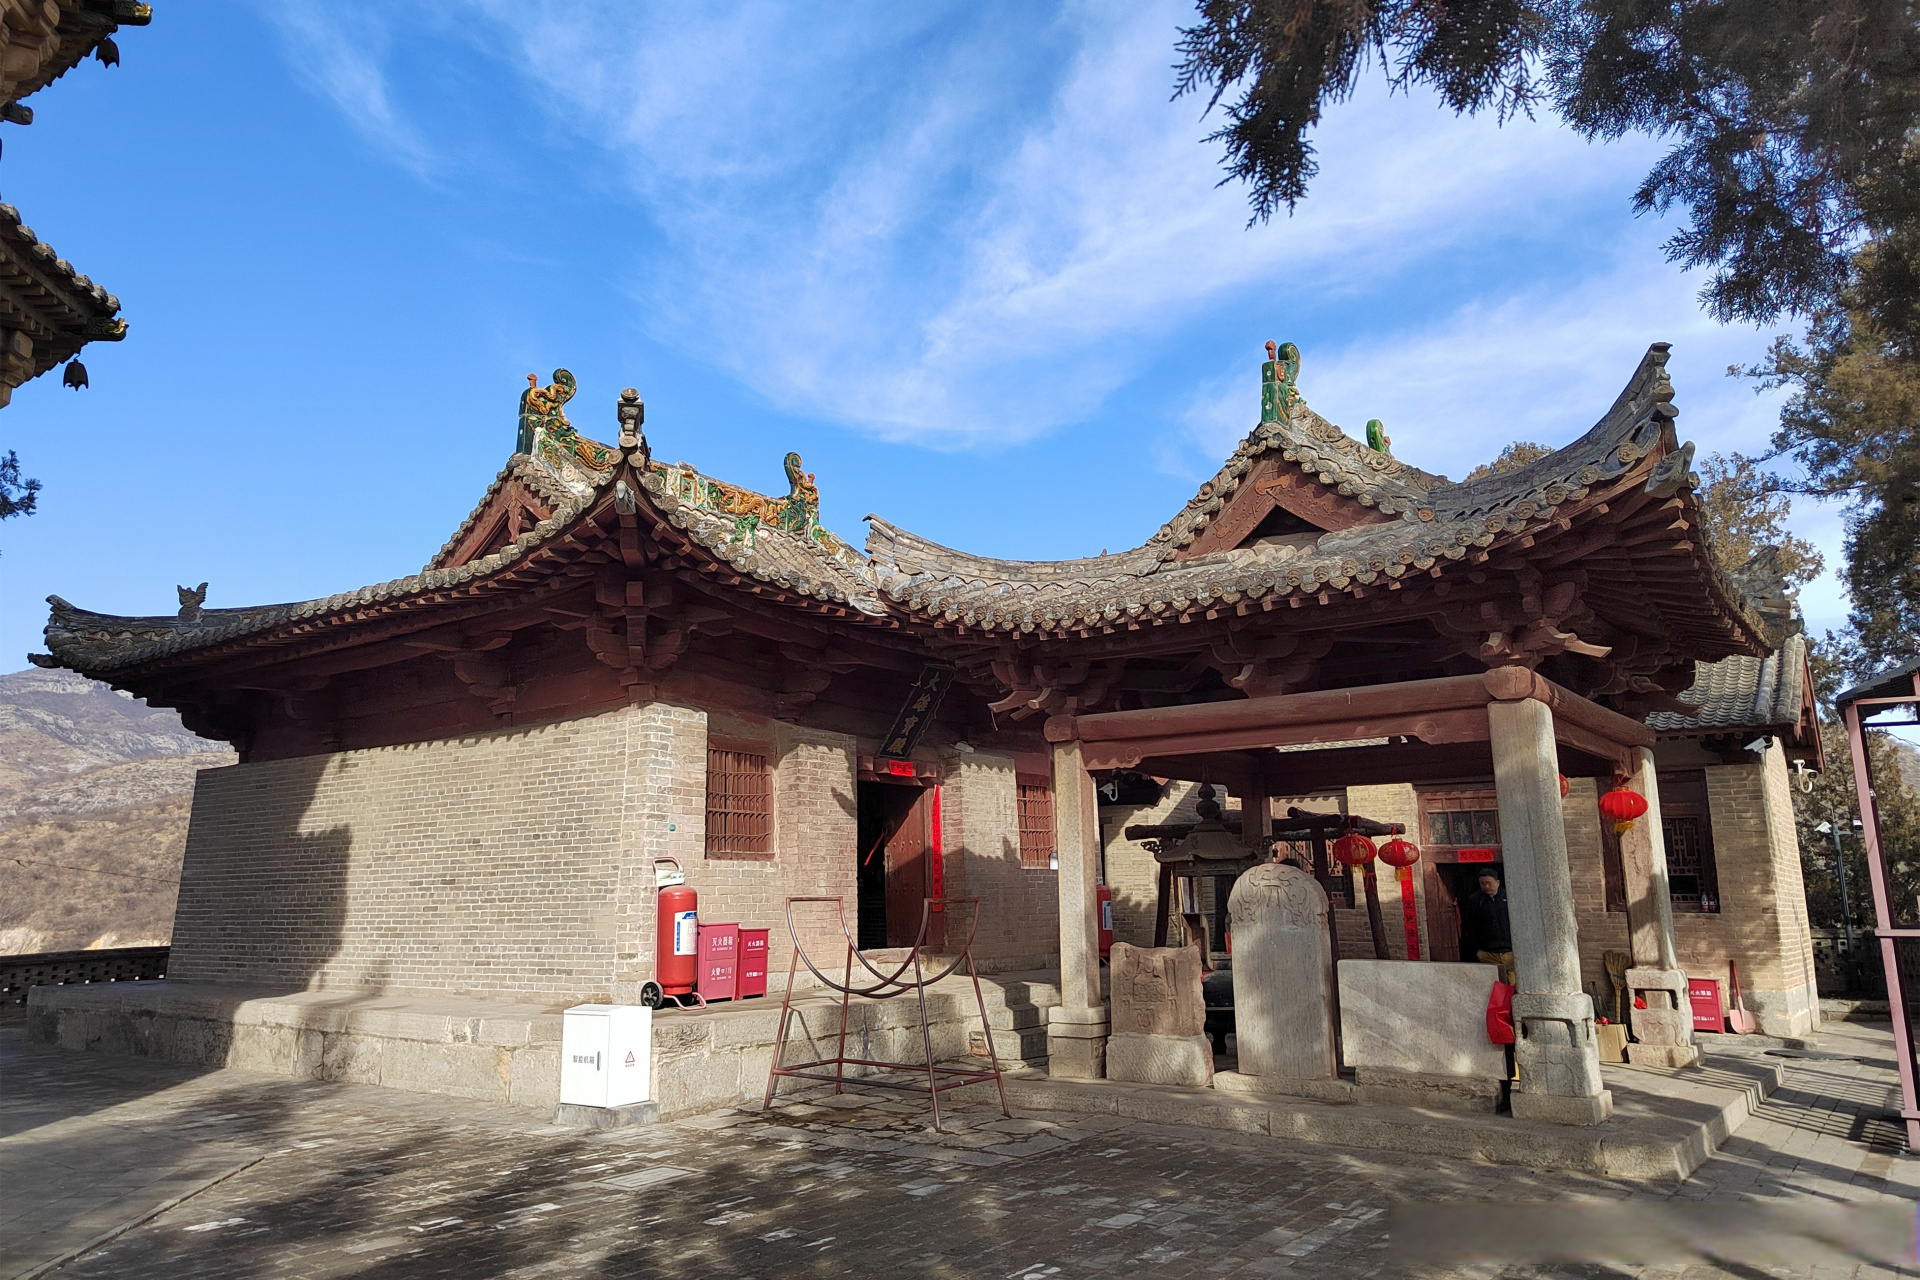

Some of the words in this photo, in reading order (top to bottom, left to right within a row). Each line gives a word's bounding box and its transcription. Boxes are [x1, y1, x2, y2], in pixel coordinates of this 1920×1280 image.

[712, 936, 733, 946] 灭火器箱
[573, 1055, 594, 1064] 智能机箱
